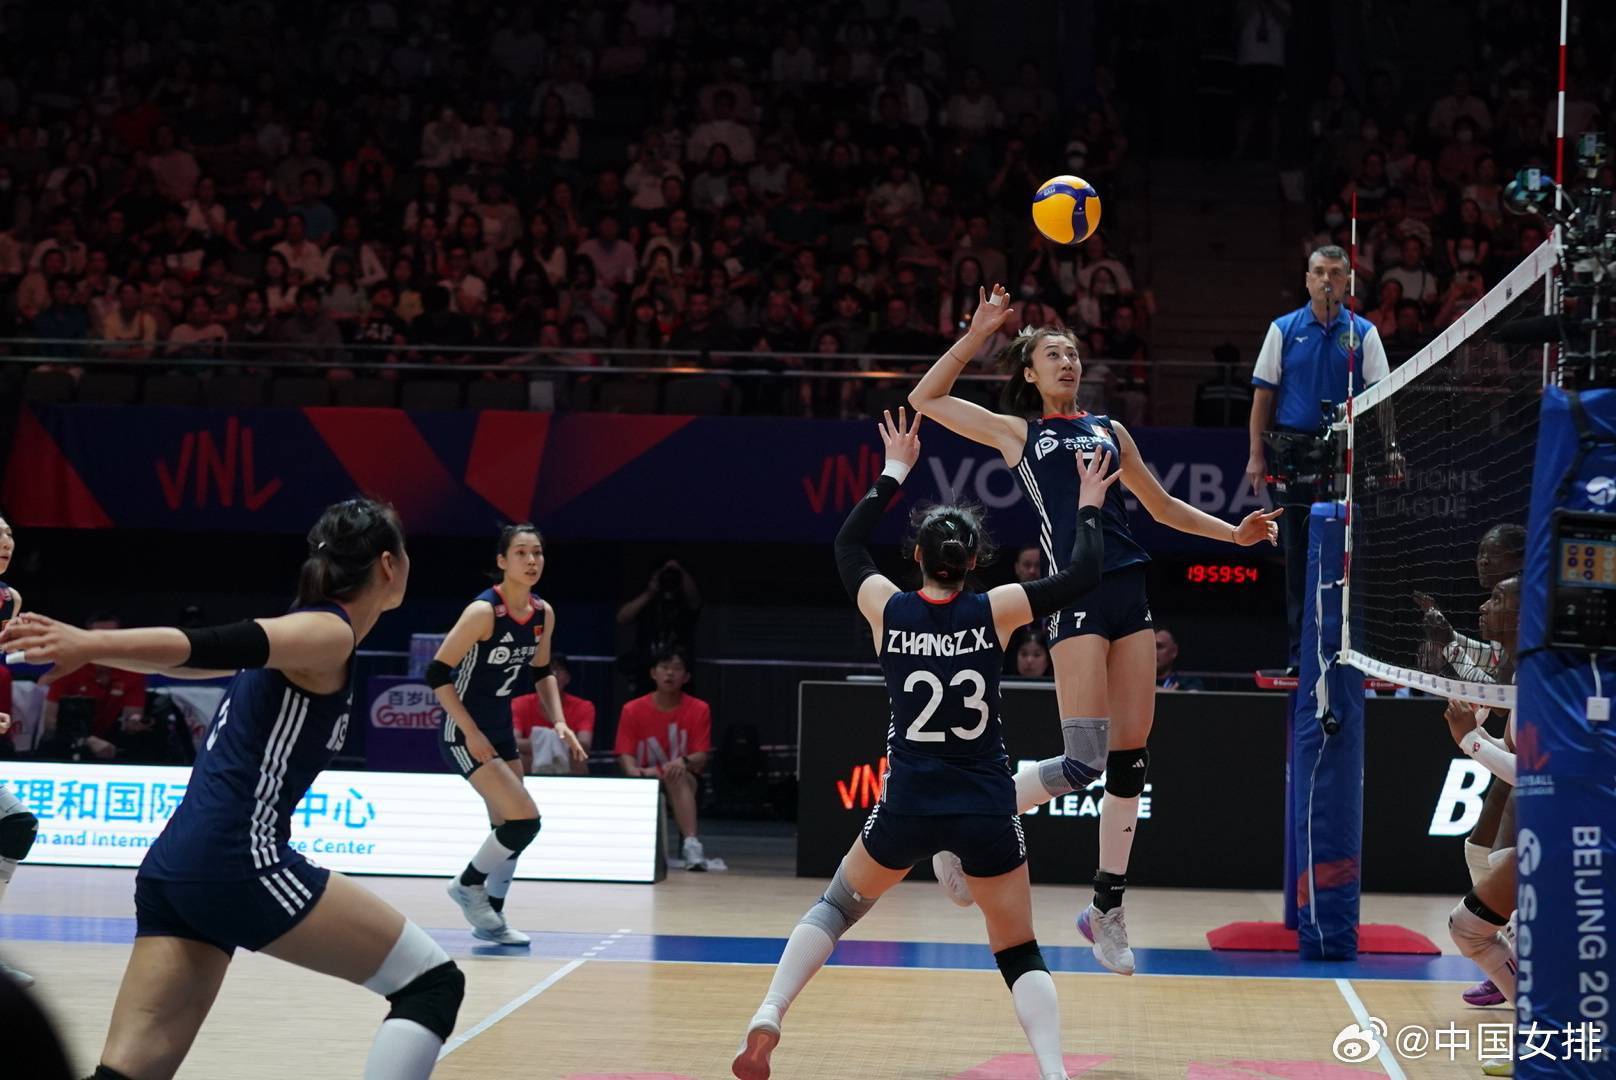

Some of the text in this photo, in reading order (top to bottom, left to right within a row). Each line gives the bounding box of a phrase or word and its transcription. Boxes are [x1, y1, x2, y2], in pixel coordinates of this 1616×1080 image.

[155, 416, 283, 511] VNL
[1186, 565, 1258, 584] 19:59:54
[1074, 612, 1086, 628] 7
[496, 665, 521, 696] 2
[389, 691, 440, 706] 百岁山
[903, 669, 989, 742] 23
[377, 704, 446, 726] Gante
[836, 757, 888, 810] VN
[0, 780, 376, 828] 理和国际中心
[1050, 796, 1151, 818] LEAE
[52, 831, 86, 847] and
[313, 838, 376, 854] Center
[1572, 826, 1608, 960] BEIJING
